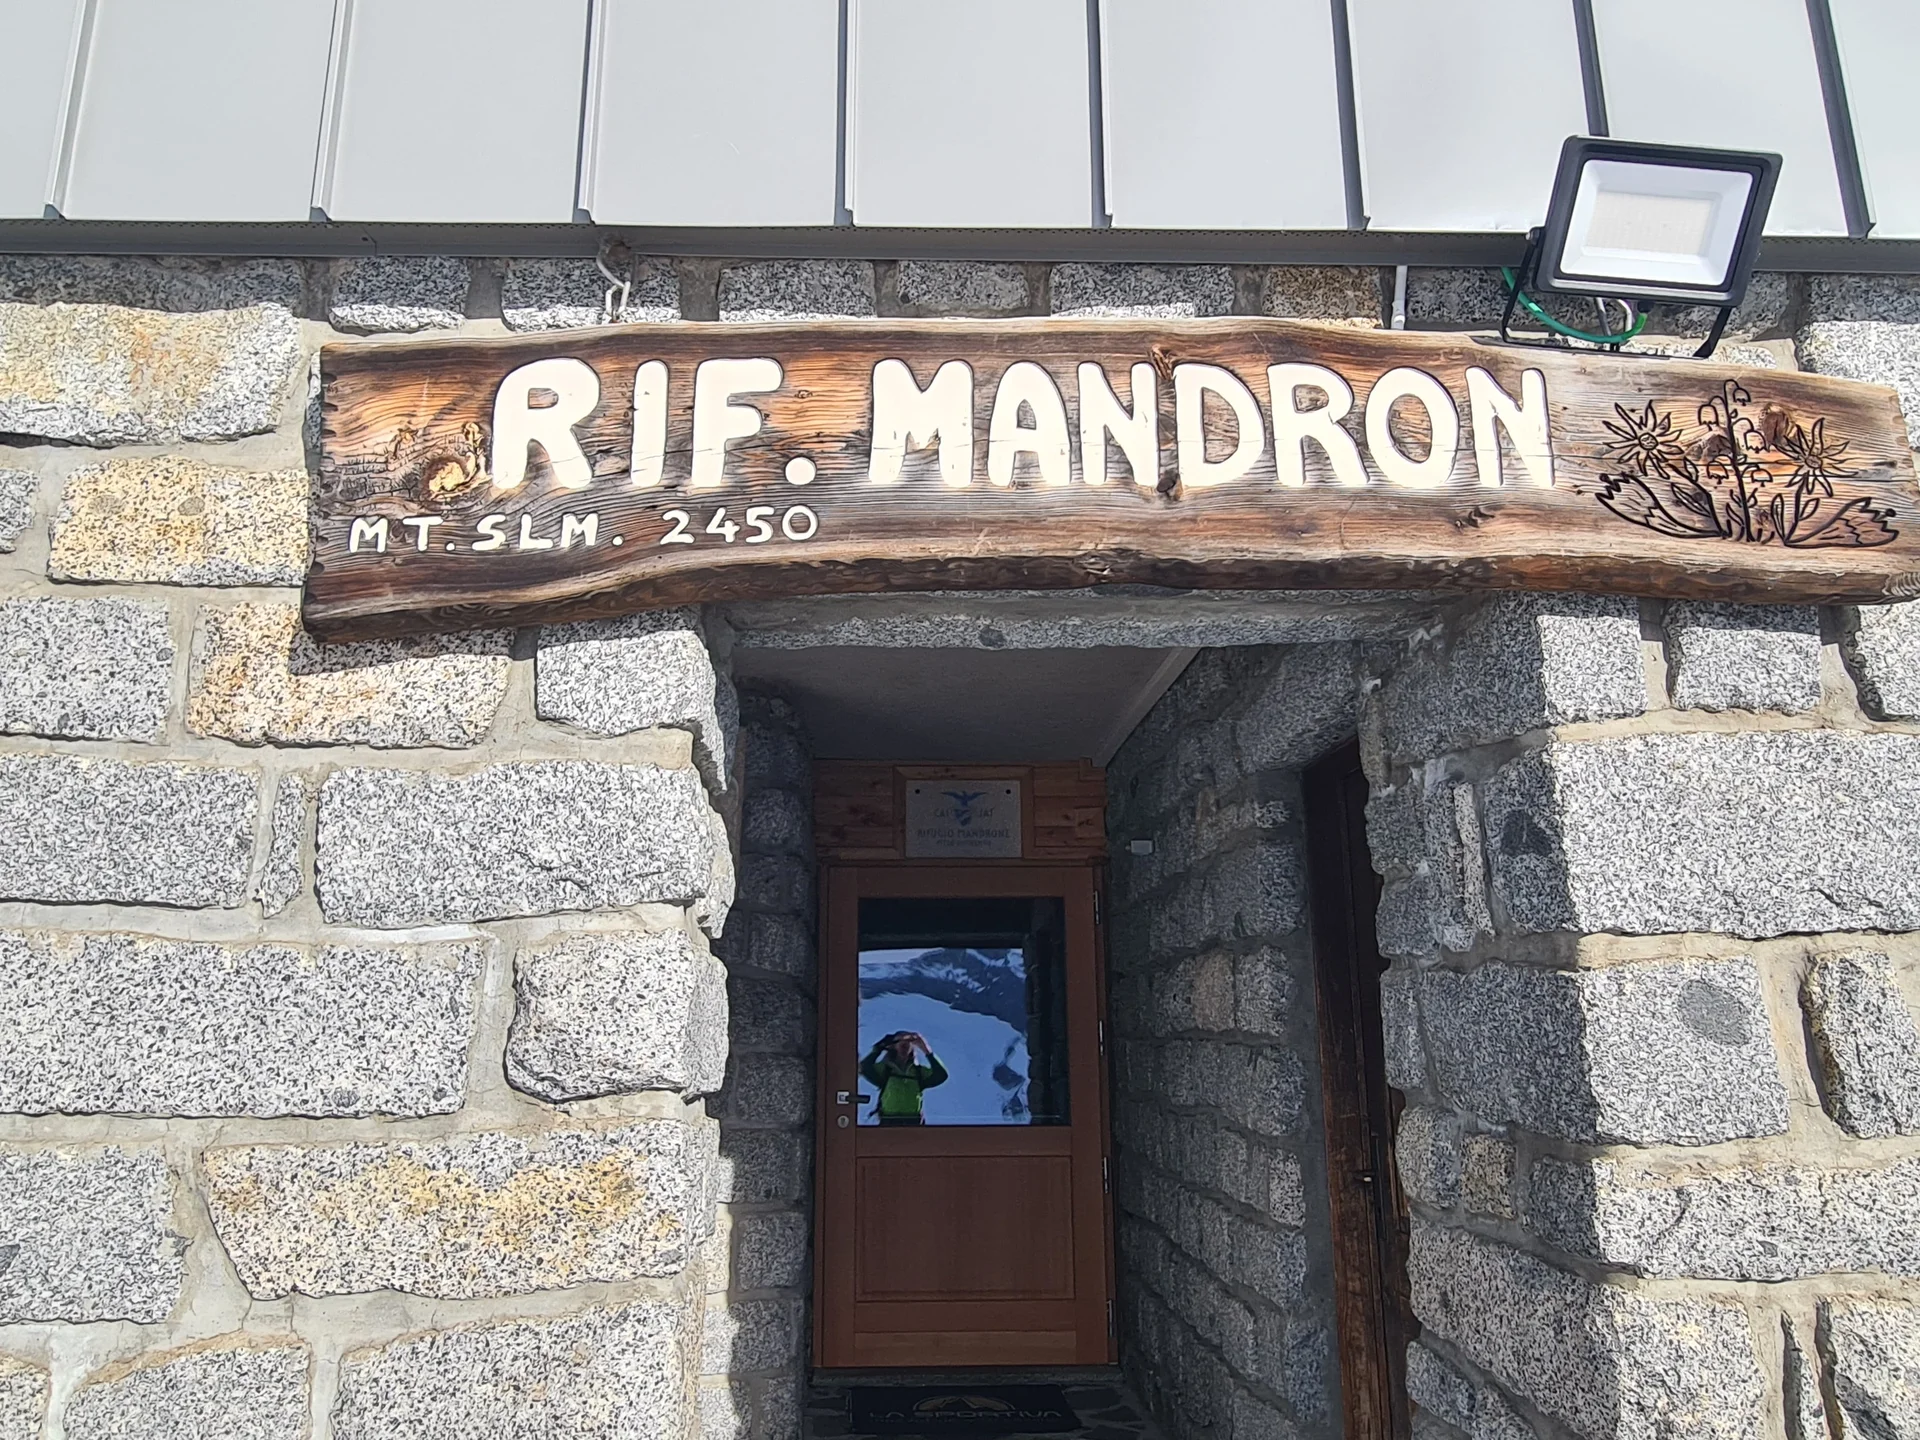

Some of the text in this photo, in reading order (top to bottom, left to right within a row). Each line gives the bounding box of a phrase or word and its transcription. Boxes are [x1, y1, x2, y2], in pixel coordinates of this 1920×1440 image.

[492, 357, 1555, 490] RIF. MANDRON
[660, 504, 819, 545] 2450
